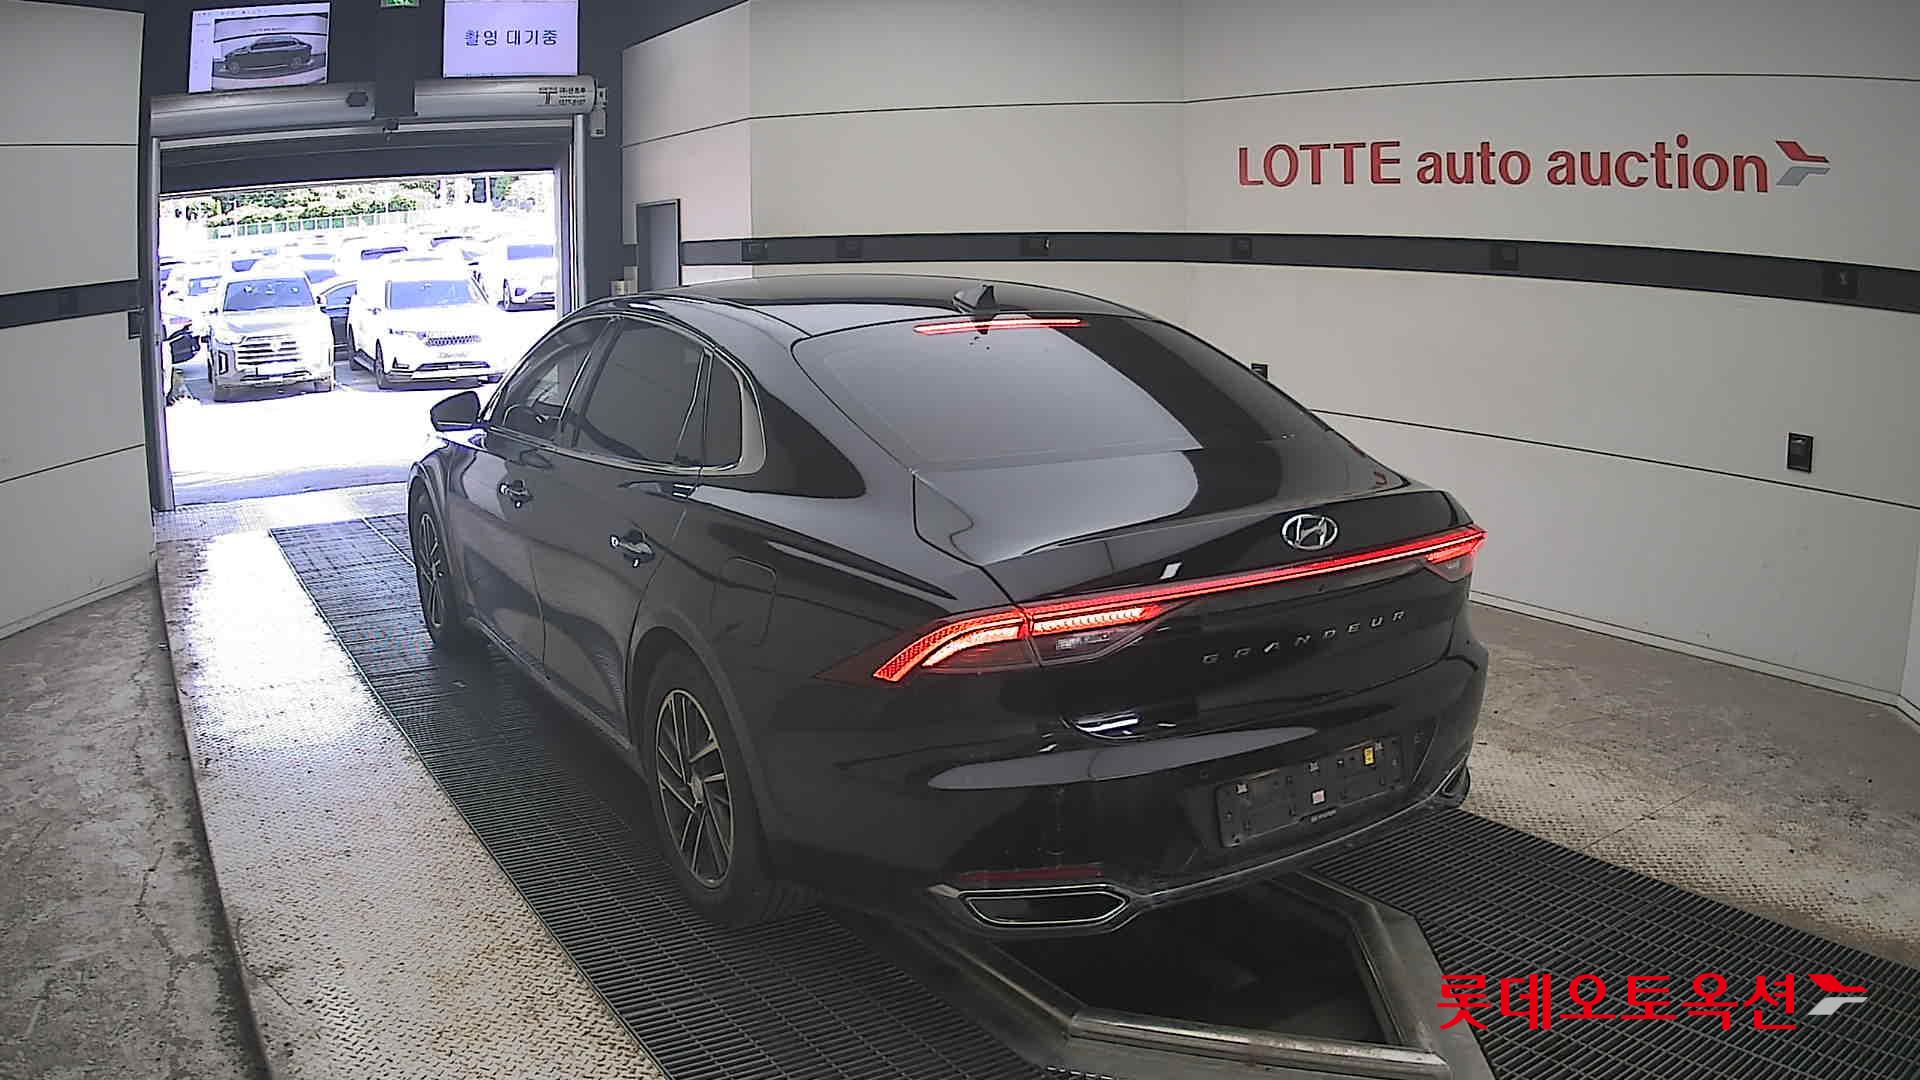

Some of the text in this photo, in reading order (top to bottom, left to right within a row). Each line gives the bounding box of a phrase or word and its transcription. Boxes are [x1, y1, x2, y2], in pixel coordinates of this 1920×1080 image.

[506, 29, 558, 46] 대기중
[1239, 134, 1769, 193] LOTTE auto auction
[1202, 610, 1405, 664] GRANDEUR
